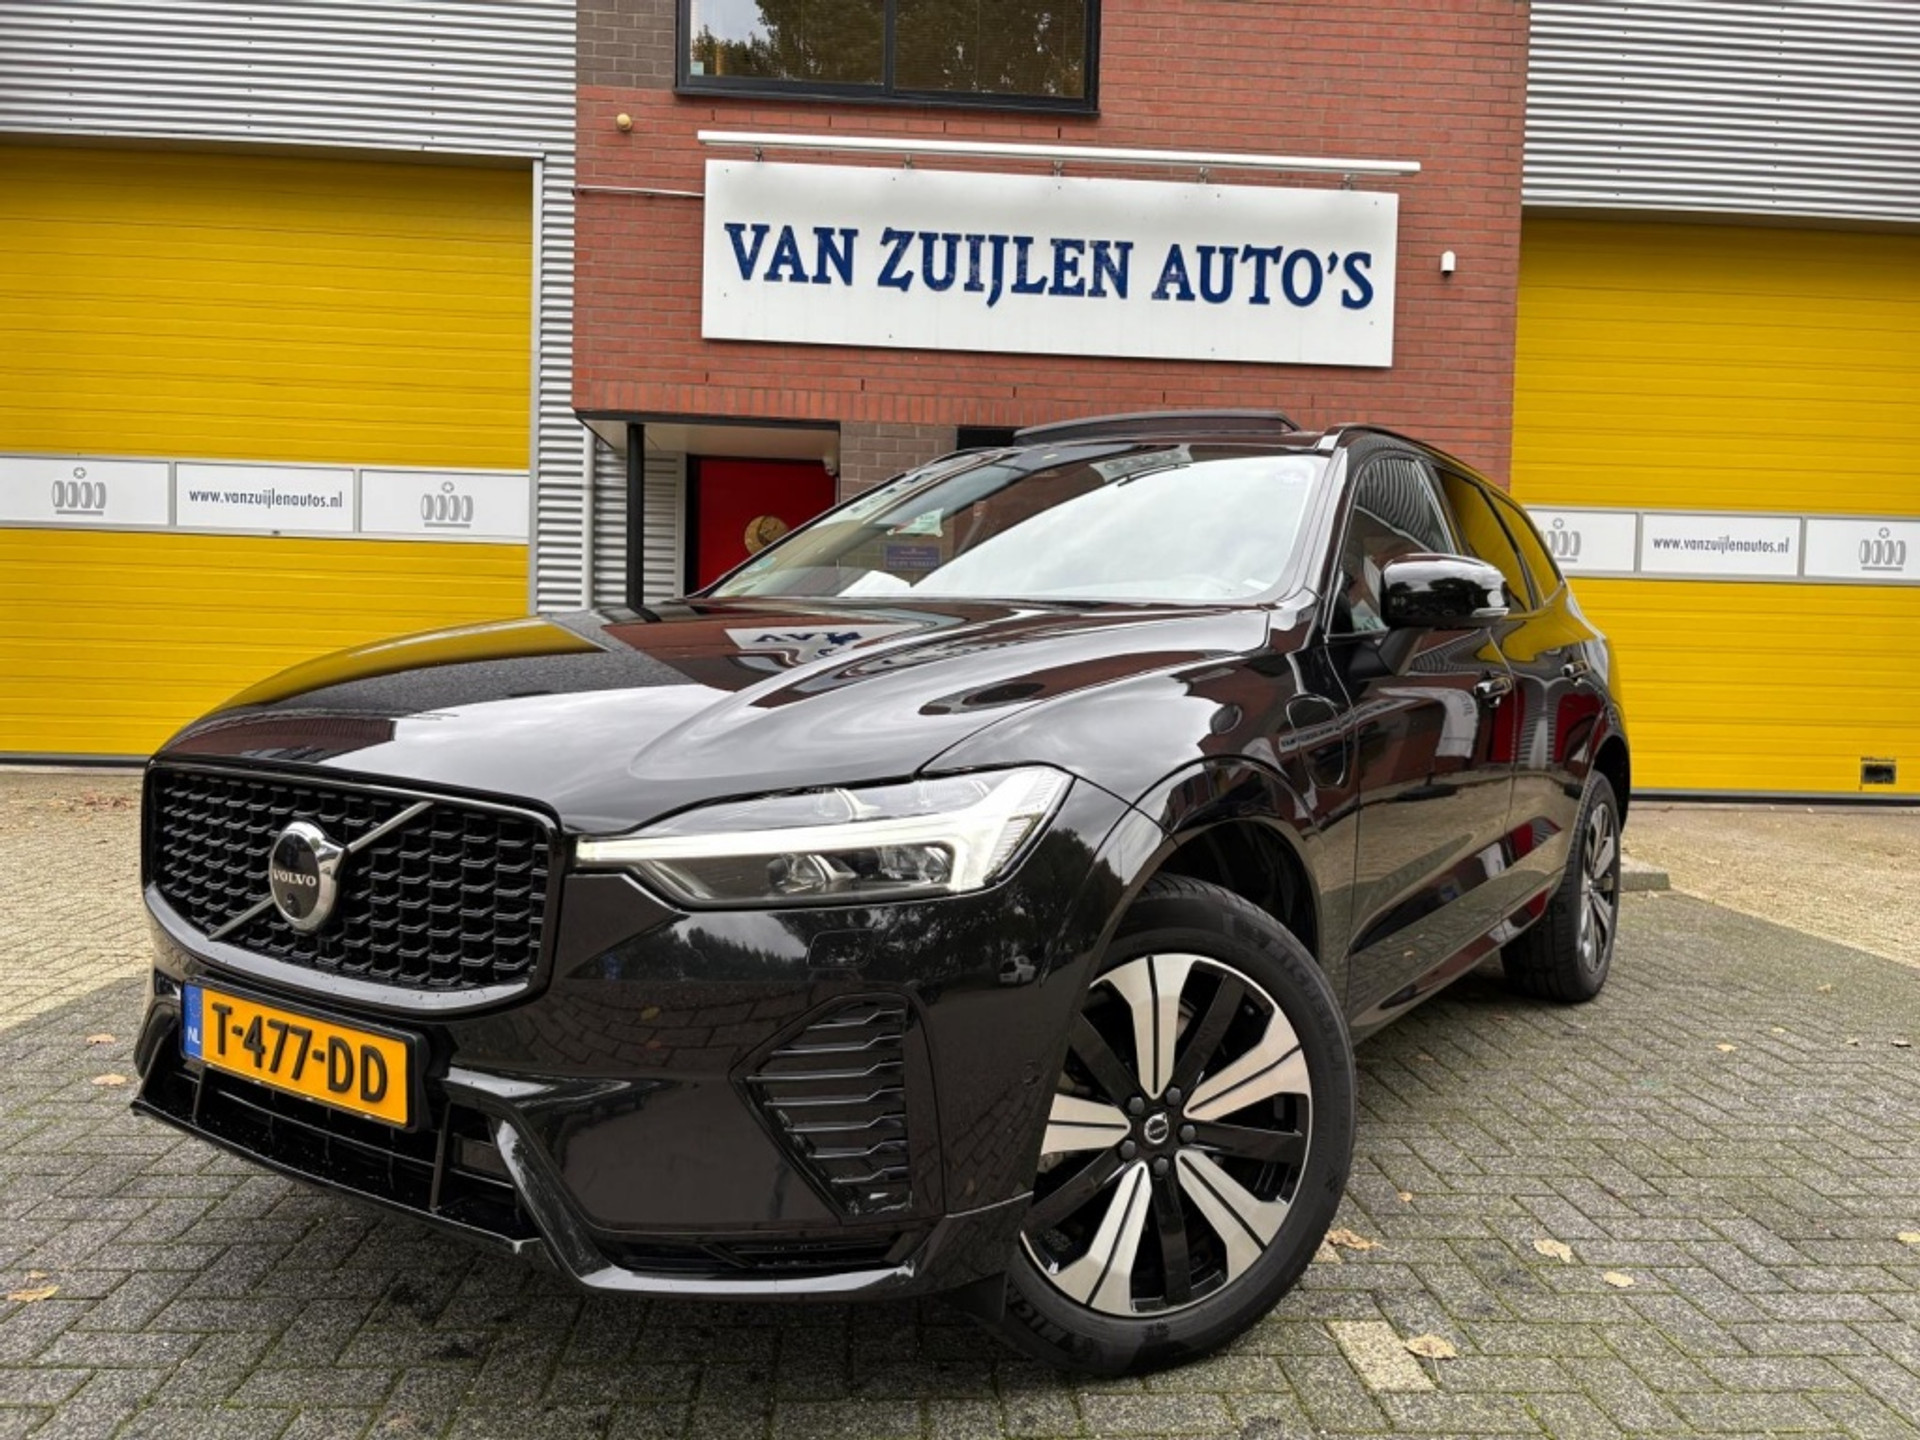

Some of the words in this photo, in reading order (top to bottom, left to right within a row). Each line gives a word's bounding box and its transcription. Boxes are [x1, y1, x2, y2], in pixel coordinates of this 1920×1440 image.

[724, 222, 859, 286] VAN
[877, 226, 1134, 308] ZUIJLEN
[1151, 243, 1374, 310] AUTO'S
[188, 487, 343, 509] www.vanzuijlenautos.nl
[1653, 535, 1790, 555] www.vanzuijlenautos.nl
[272, 868, 318, 888] VOLVO
[187, 1026, 201, 1044] NL
[211, 1001, 388, 1104] T-477-DD
